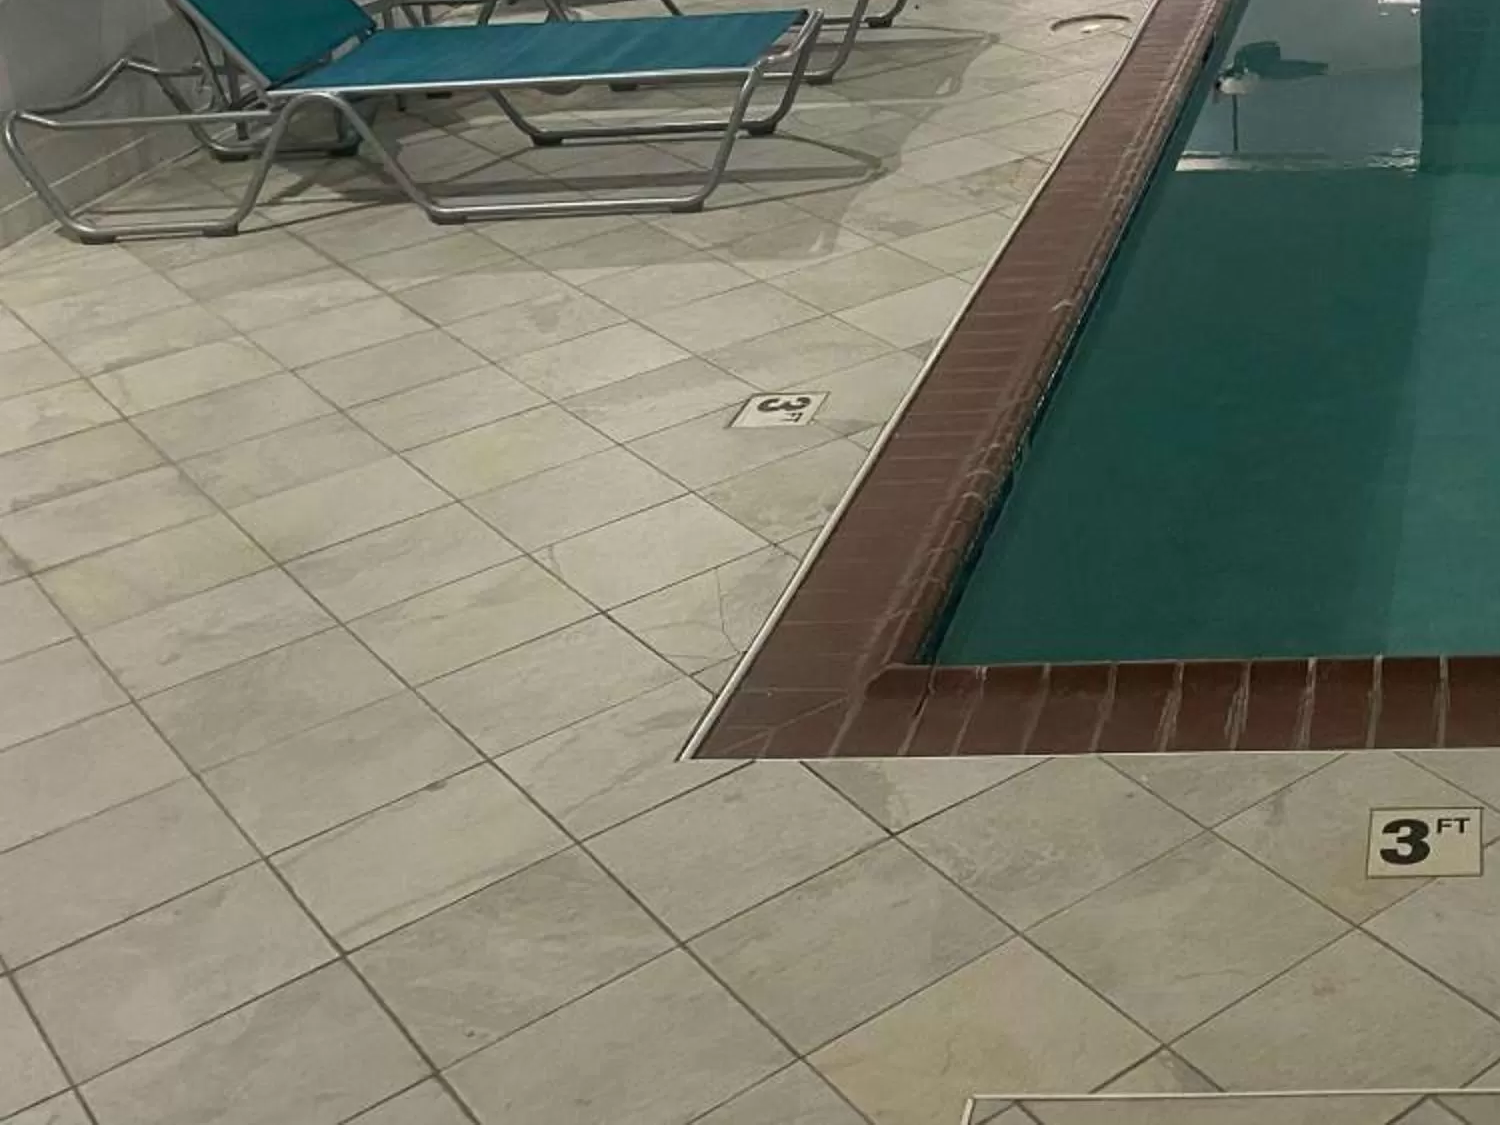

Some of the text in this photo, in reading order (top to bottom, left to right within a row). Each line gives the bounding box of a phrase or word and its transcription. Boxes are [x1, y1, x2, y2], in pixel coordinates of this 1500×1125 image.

[757, 397, 811, 412] 3
[1380, 817, 1470, 865] 3 FT
